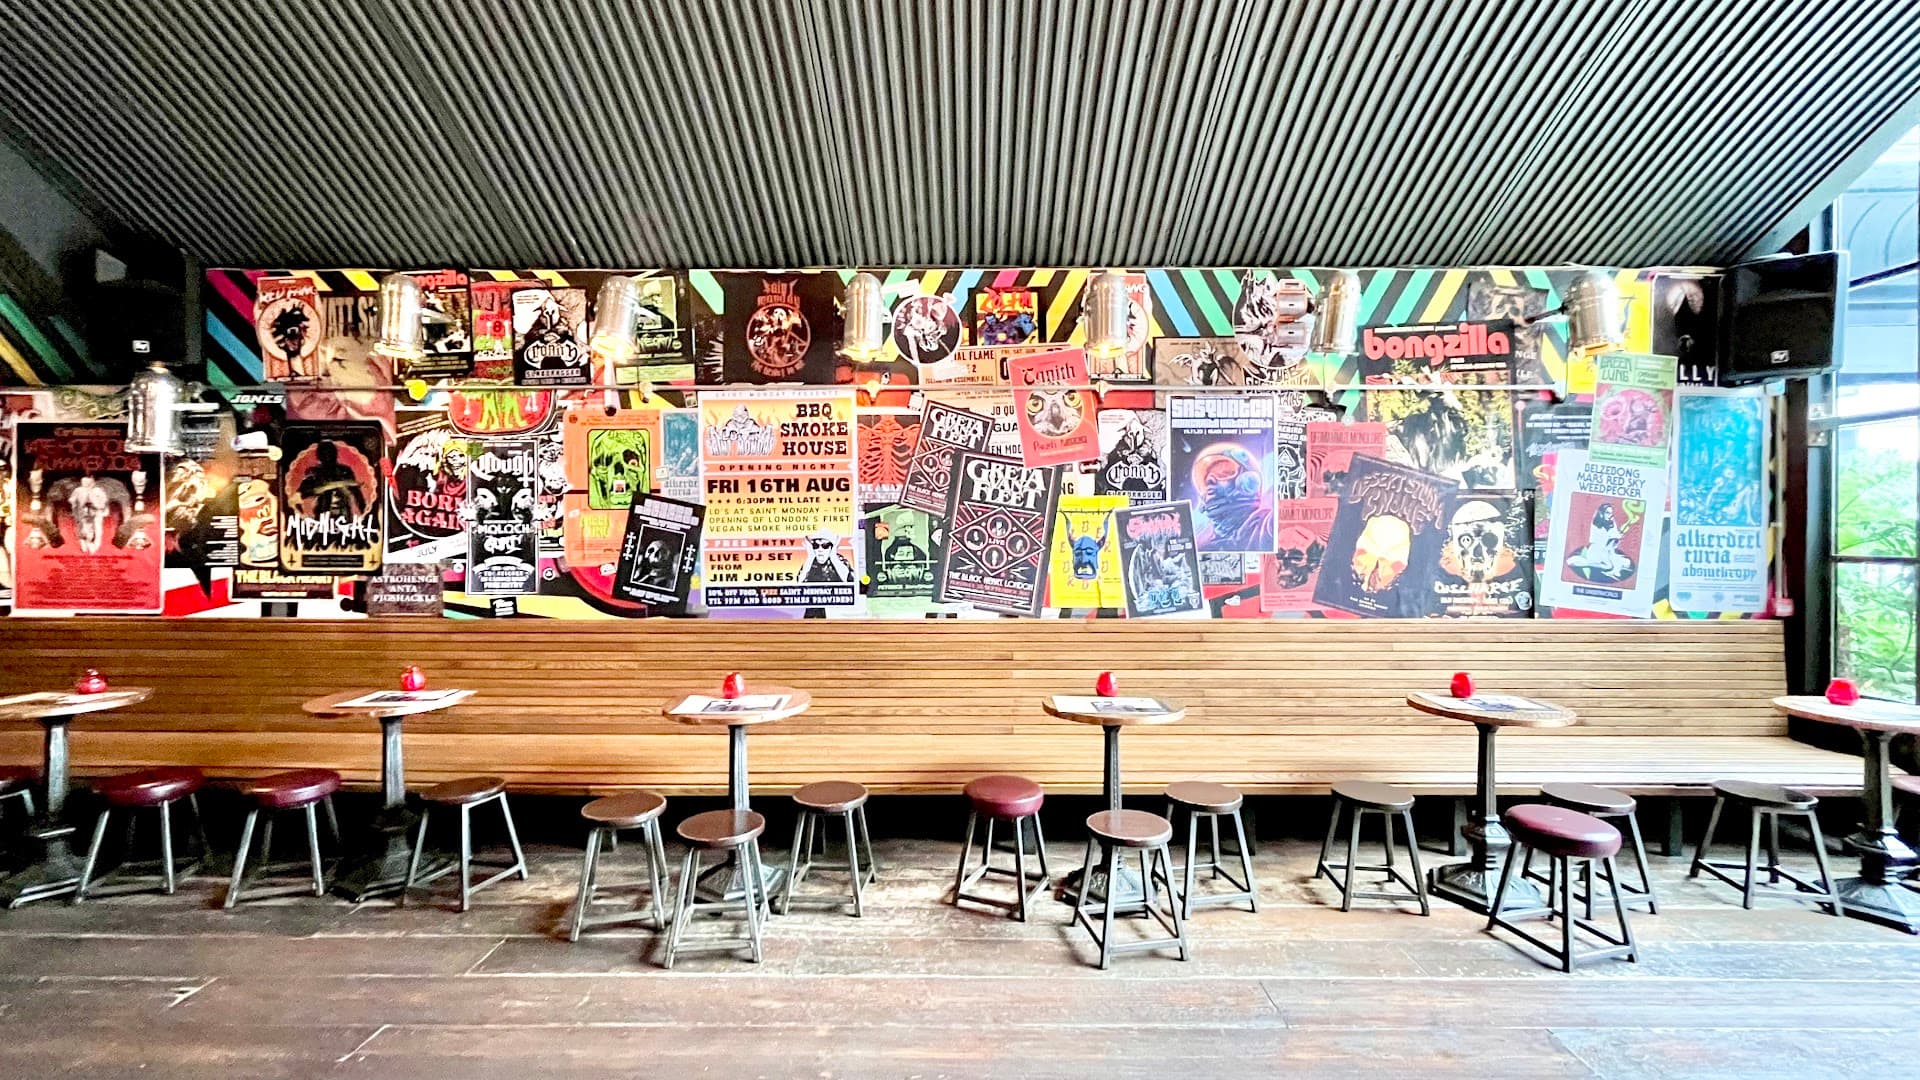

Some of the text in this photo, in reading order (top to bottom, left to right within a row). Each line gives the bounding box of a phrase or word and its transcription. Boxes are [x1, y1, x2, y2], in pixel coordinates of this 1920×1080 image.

[1363, 322, 1510, 367] bongzilla
[969, 349, 995, 361] FLAME
[1022, 362, 1076, 386] Tanith
[1679, 364, 1716, 381] LLY
[231, 394, 285, 404] JONES
[796, 403, 832, 420] BBQ
[991, 405, 1015, 416] JO QU
[780, 421, 849, 438] SMOKE
[930, 408, 984, 437] GRETA
[931, 421, 981, 449] FLEET
[782, 440, 847, 456] HOUSE
[792, 463, 836, 471] NIGHT
[967, 459, 1046, 491] GRETA
[707, 477, 850, 494] FRI 16TH AUG
[1577, 472, 1647, 488] MARS RED SKY
[971, 481, 1043, 510] FLEET
[1578, 481, 1642, 498] WEEDPECKER
[406, 490, 467, 512] BORN
[736, 497, 775, 505] 6:30PM
[797, 496, 821, 504] LATE
[401, 508, 467, 531] AGAIN
[709, 516, 749, 524] OPENING
[477, 524, 530, 535] MOLOCH
[709, 525, 743, 533] VEGAN
[785, 524, 817, 532] HOUSE
[714, 539, 796, 547] FREE ENTRY
[709, 552, 793, 562] LIVE DJ SET
[234, 569, 257, 583] THE
[709, 572, 794, 583] JIM JONES
[961, 573, 982, 583] BLACK
[1005, 579, 1034, 591] LONDON
[389, 585, 418, 593] ANTA
